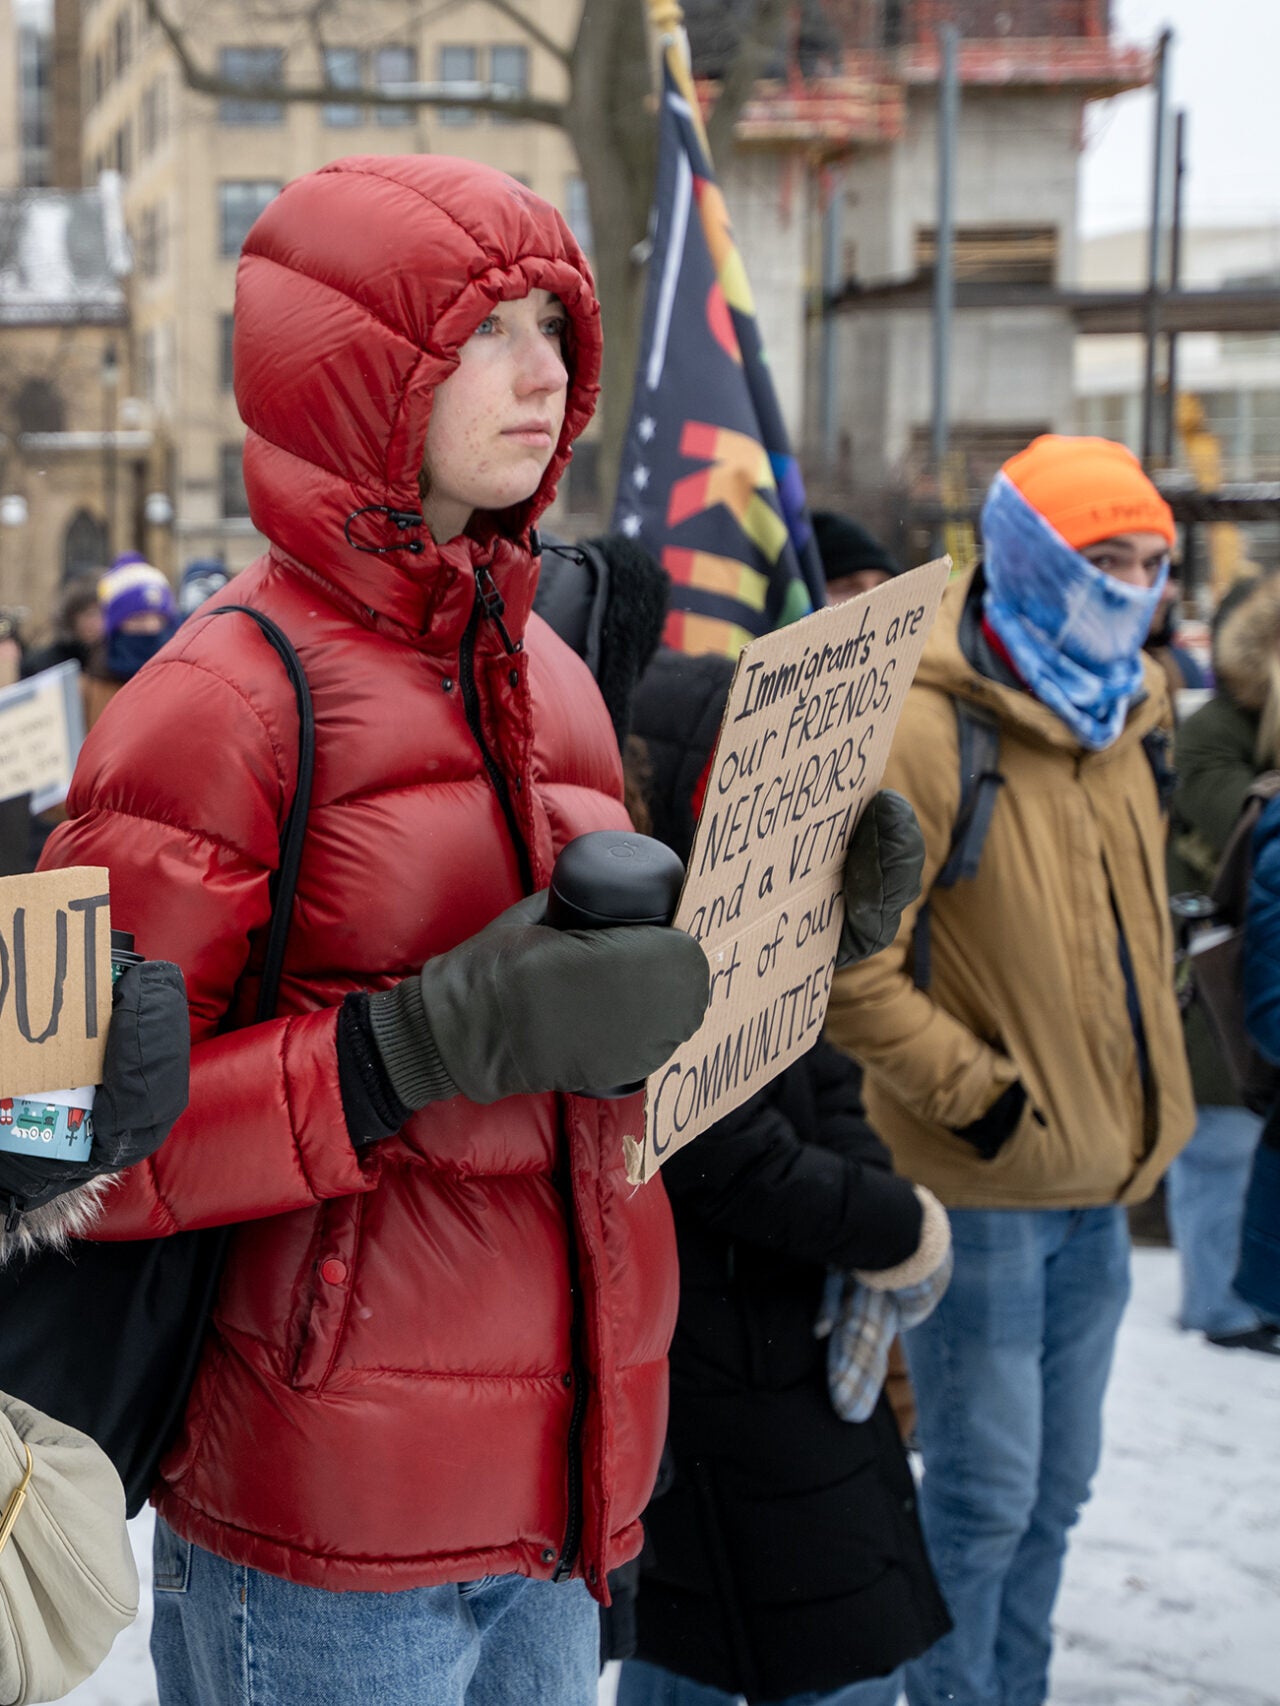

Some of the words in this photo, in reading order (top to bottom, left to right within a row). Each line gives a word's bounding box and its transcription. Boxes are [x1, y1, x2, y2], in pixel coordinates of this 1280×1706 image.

[734, 606, 876, 722] Immigrants
[885, 605, 925, 646] are
[718, 730, 777, 795] our
[781, 659, 897, 760] FRIENDS,
[699, 725, 873, 877] NEIGHBORS,
[686, 859, 752, 943] and
[757, 865, 774, 900] a
[708, 941, 741, 1008] rt
[757, 911, 789, 978] of
[795, 890, 844, 948] our
